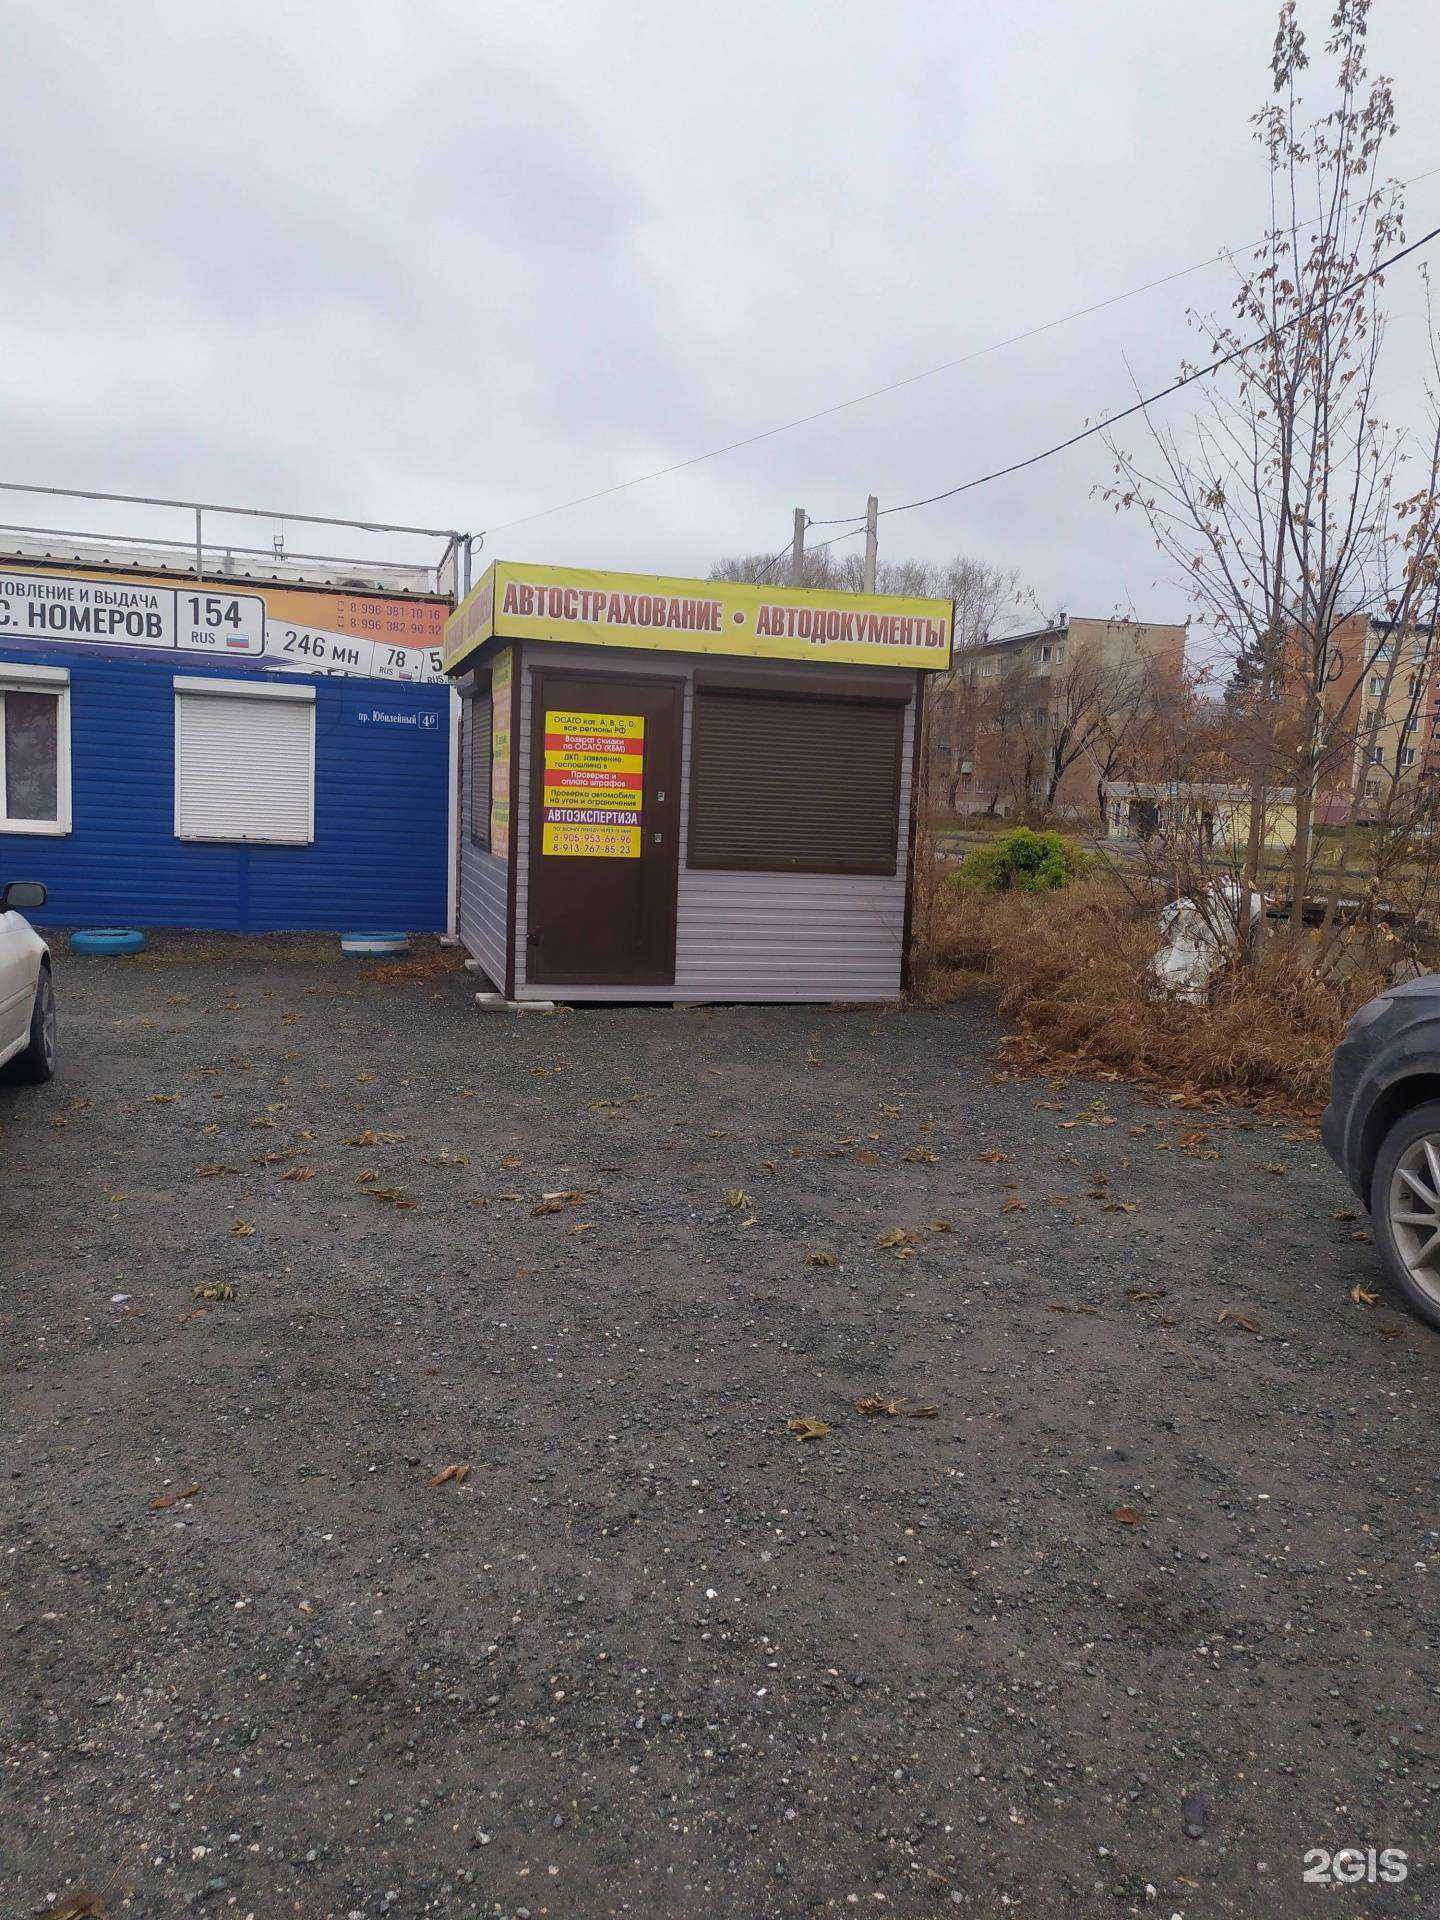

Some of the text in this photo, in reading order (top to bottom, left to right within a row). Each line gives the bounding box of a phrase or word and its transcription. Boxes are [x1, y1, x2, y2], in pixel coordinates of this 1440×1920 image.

[80, 588, 89, 602] И
[94, 590, 158, 609] ВЫДАЧА
[28, 602, 163, 638] НОМЕРОВ
[188, 598, 242, 629] 154
[503, 583, 722, 632] АВТОСТРАХОВАНИЕ
[757, 605, 945, 648] АВТОДОКУМЕНТЫ
[191, 631, 216, 644] RUS
[283, 630, 326, 657] 246
[387, 648, 406, 668] 78
[379, 666, 394, 676] RUS
[358, 713, 370, 723] пр.
[372, 710, 417, 725] Юбилейный
[554, 716, 582, 725] ОСАГО
[565, 735, 595, 744] Возврат
[574, 743, 603, 751] ОСАГО
[571, 770, 610, 780] Проверка
[561, 778, 627, 788] оплата штрафов
[550, 789, 590, 798] Проверка
[587, 799, 637, 807] ограничения
[547, 809, 638, 824] АВТОЭКСПЕРТИЗА
